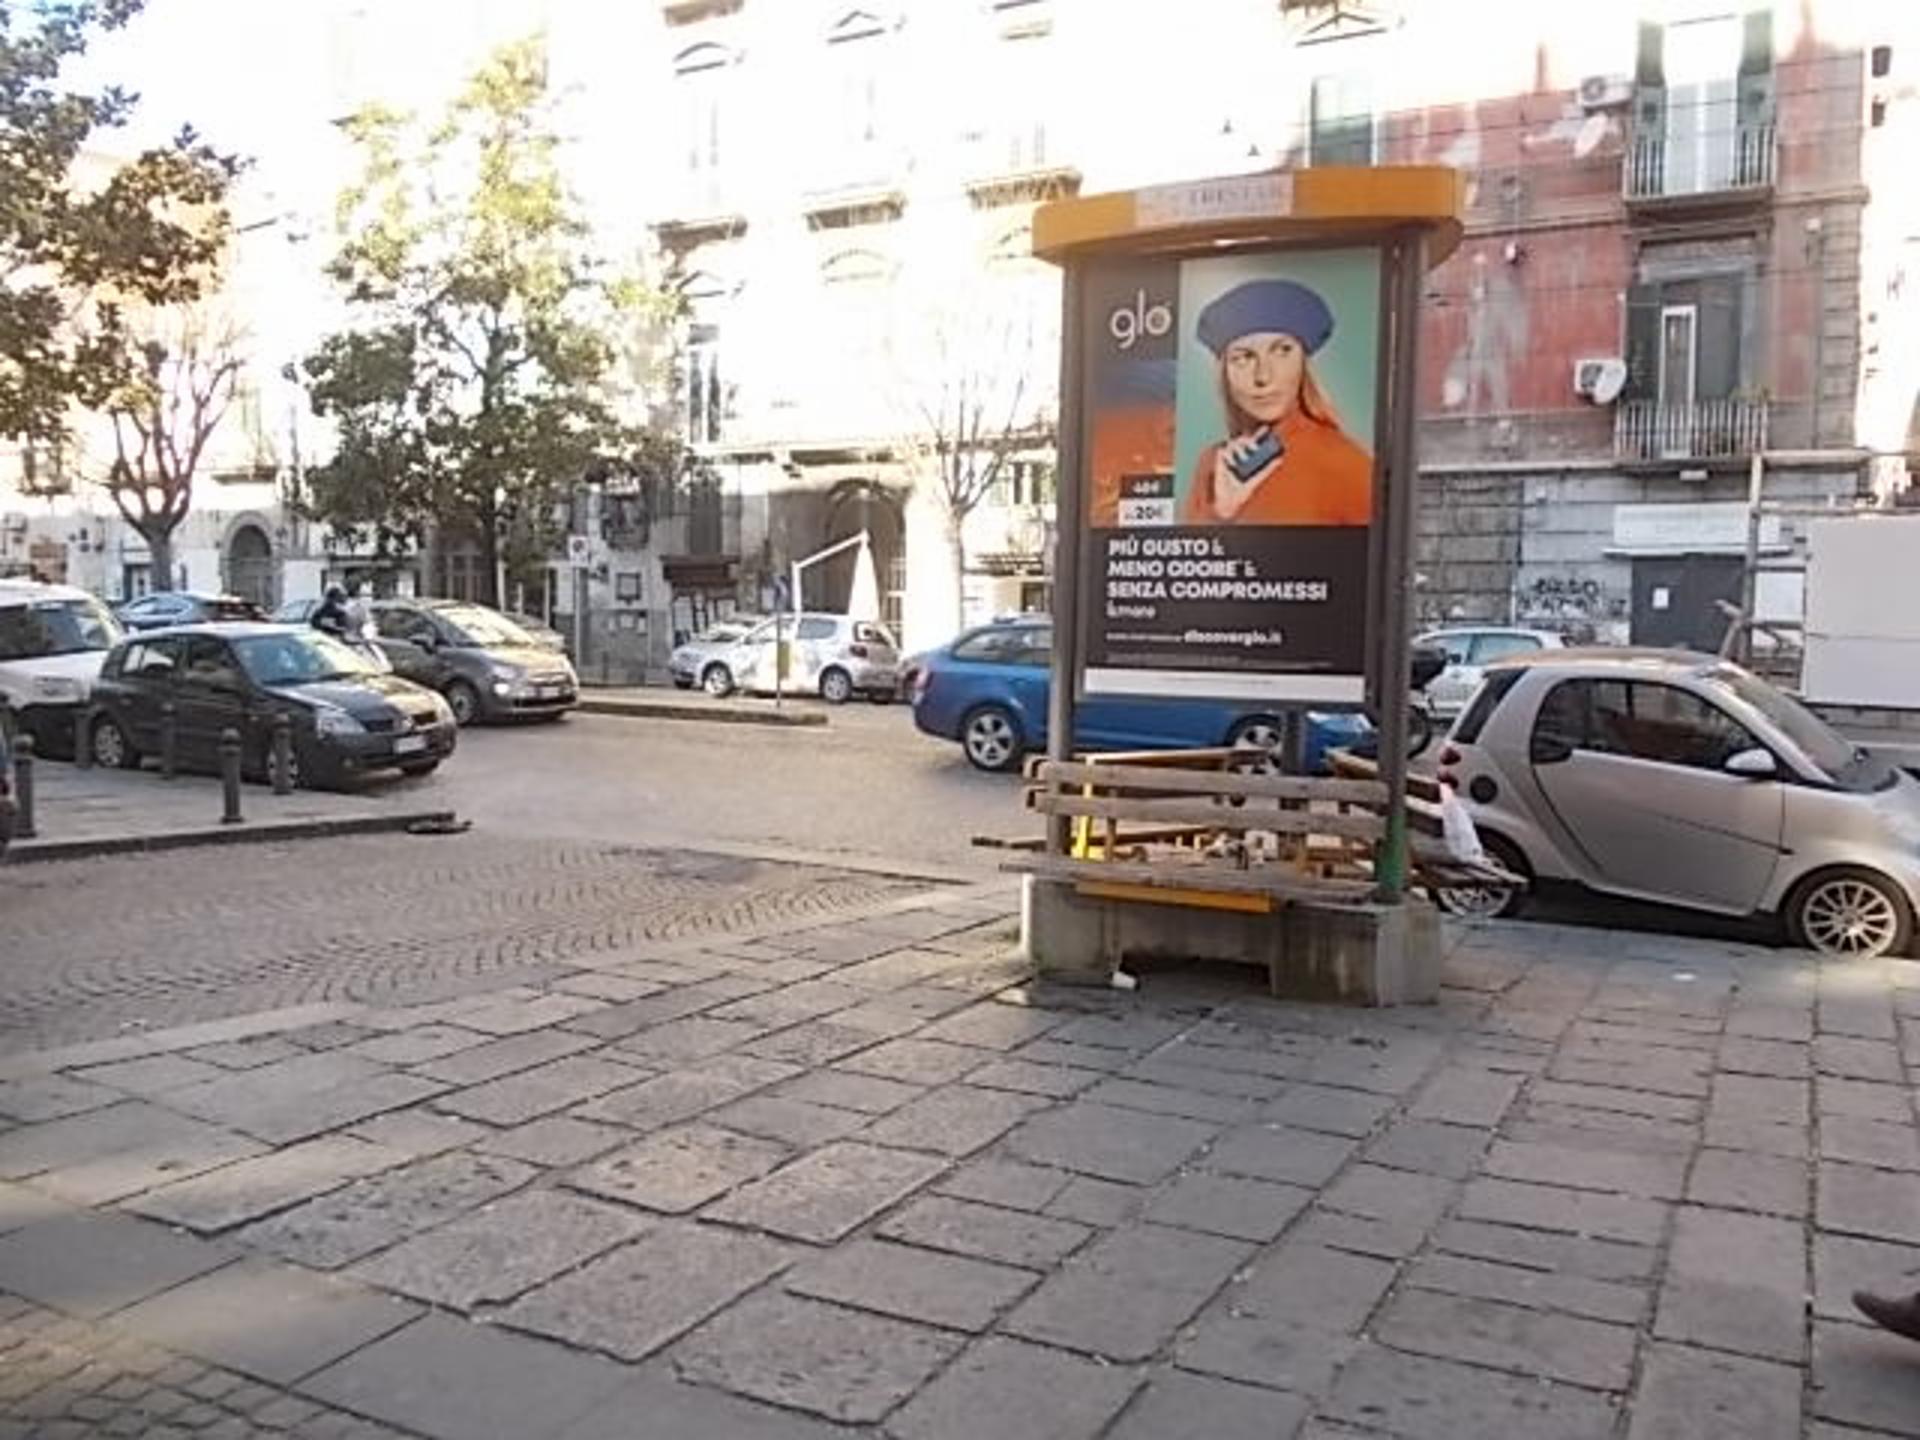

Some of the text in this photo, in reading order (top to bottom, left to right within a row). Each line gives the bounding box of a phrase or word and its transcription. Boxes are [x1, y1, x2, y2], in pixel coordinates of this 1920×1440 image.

[1110, 288, 1172, 349] glo
[1142, 539, 1209, 556] GUSTO
[1107, 560, 1164, 577] MENO
[1107, 581, 1328, 600] SENZA COMPROMESSI
